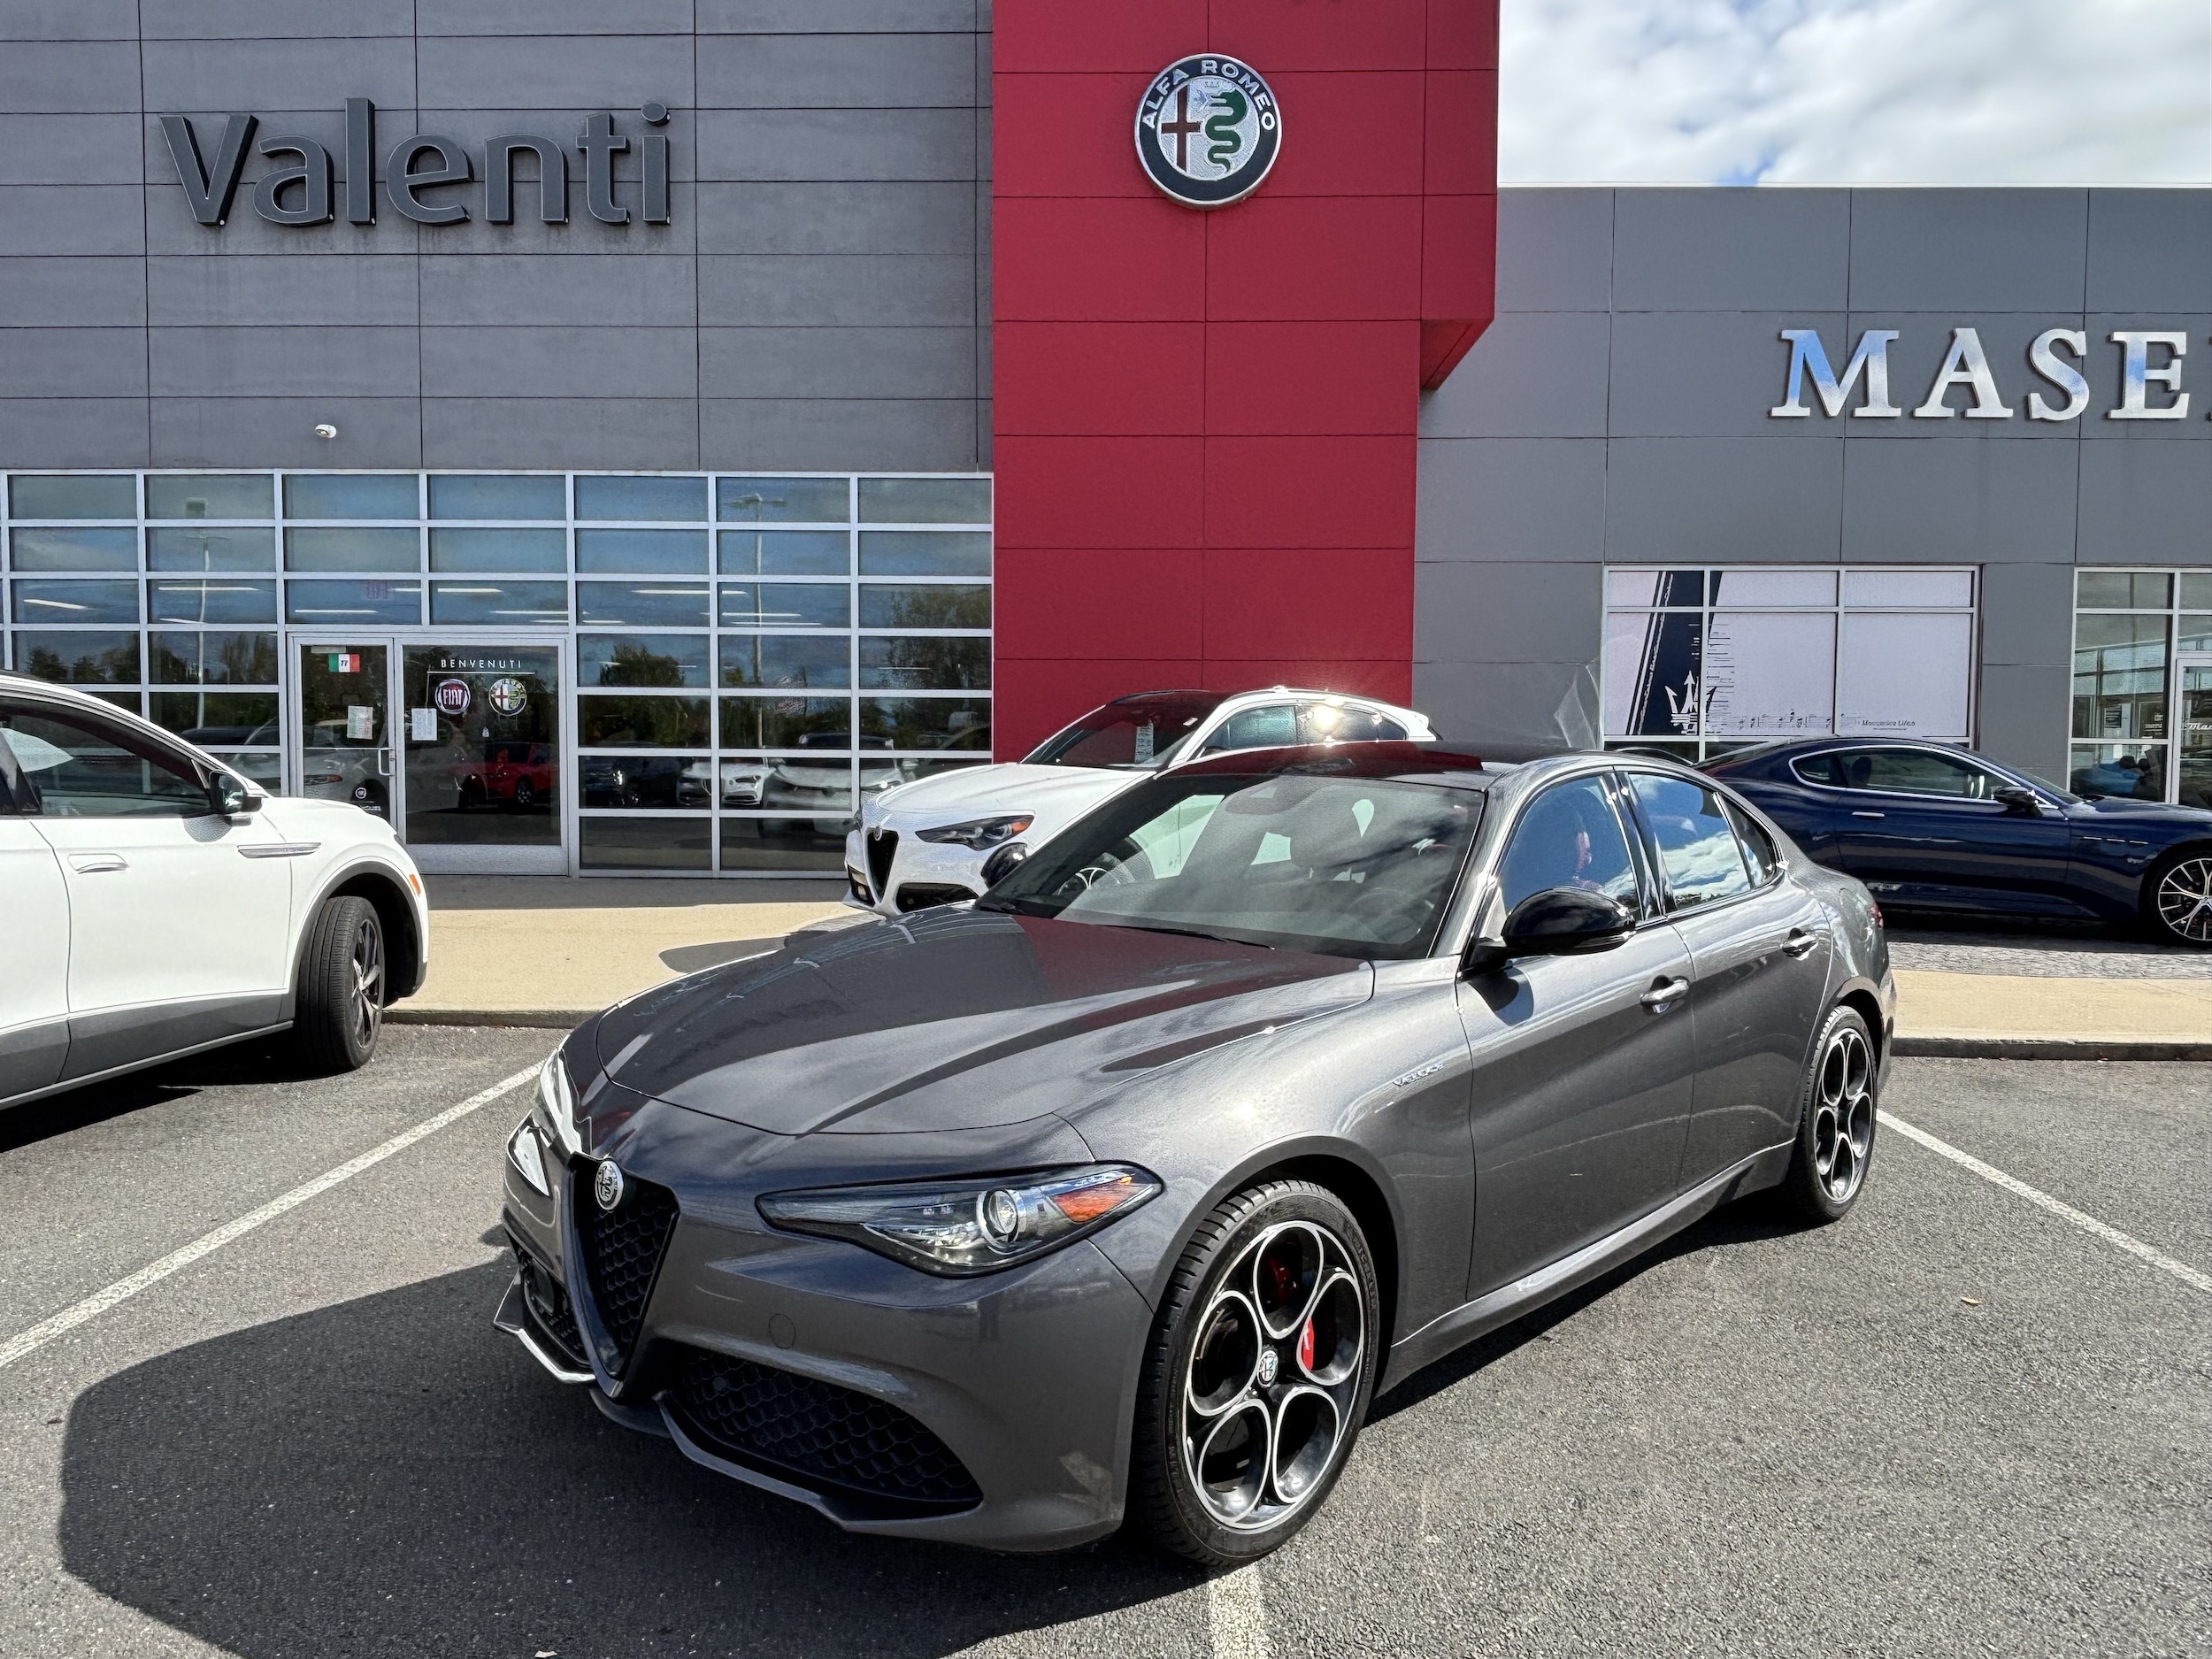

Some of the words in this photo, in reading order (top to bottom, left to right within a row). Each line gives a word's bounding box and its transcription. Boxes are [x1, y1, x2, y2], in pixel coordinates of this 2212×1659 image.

[1142, 68, 1190, 129] ALFA
[1201, 59, 1276, 131] ROMEO
[157, 97, 672, 227] Valenti
[1770, 327, 2212, 422] MASE
[441, 659, 521, 669] BENVENUTI
[443, 688, 464, 706] FIAT
